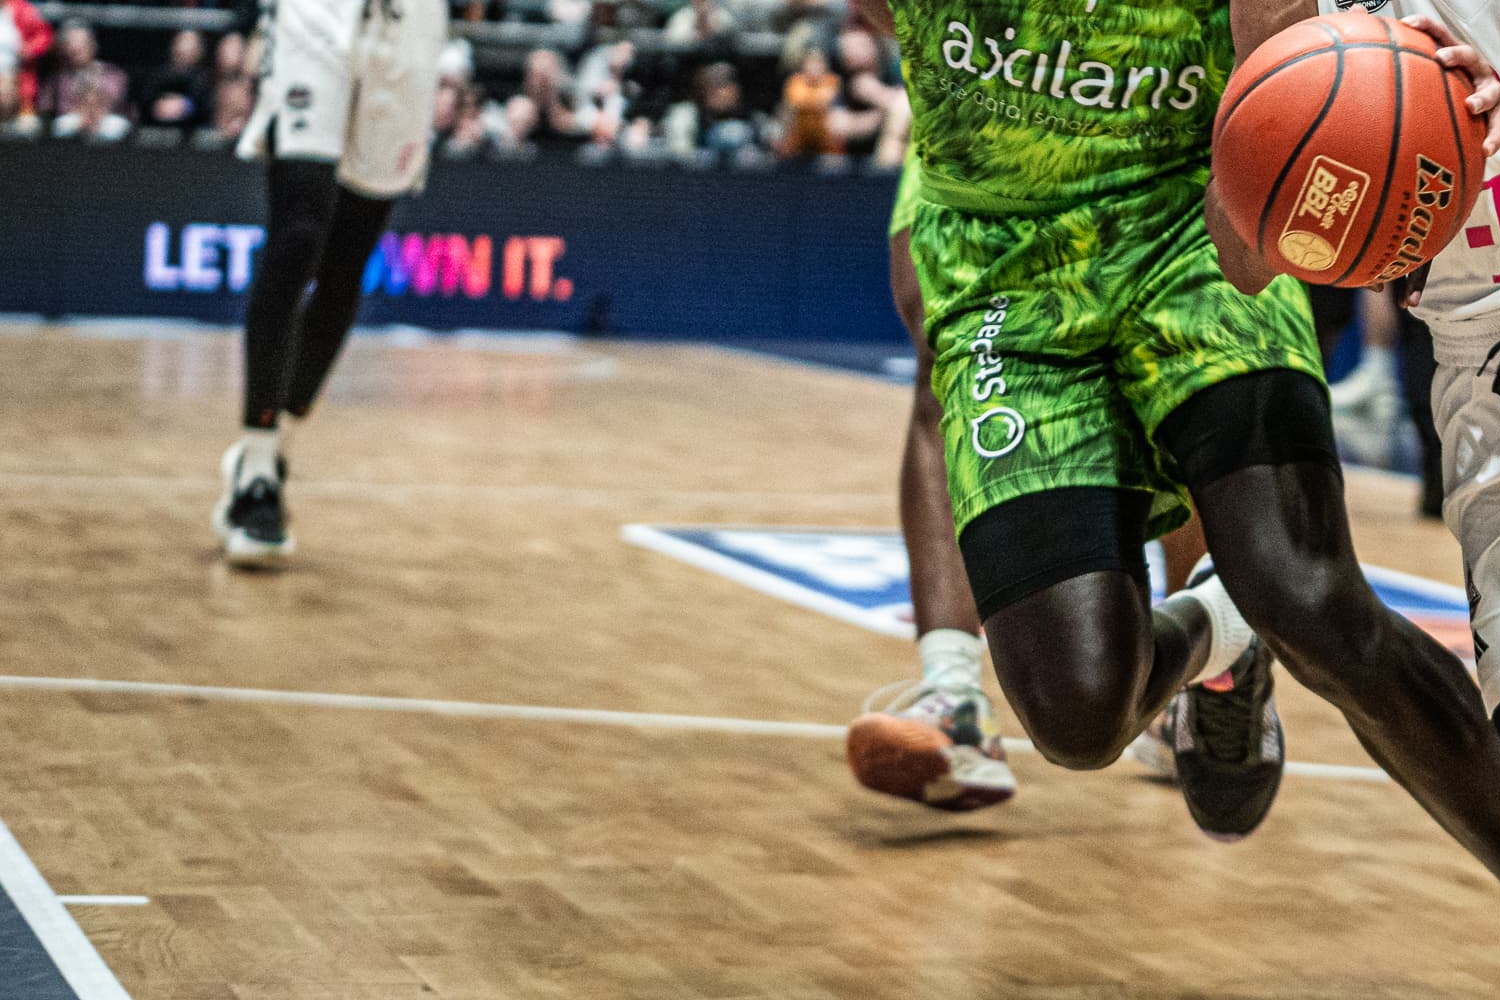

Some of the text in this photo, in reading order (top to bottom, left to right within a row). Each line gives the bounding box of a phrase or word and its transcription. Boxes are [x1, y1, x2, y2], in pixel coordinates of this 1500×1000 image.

[1358, 0, 1377, 9] ONN
[943, 21, 1206, 110] axilaris
[1299, 166, 1338, 219] BBL
[1366, 153, 1455, 286] Bade
[143, 222, 266, 293] LET
[502, 235, 574, 301] IT.
